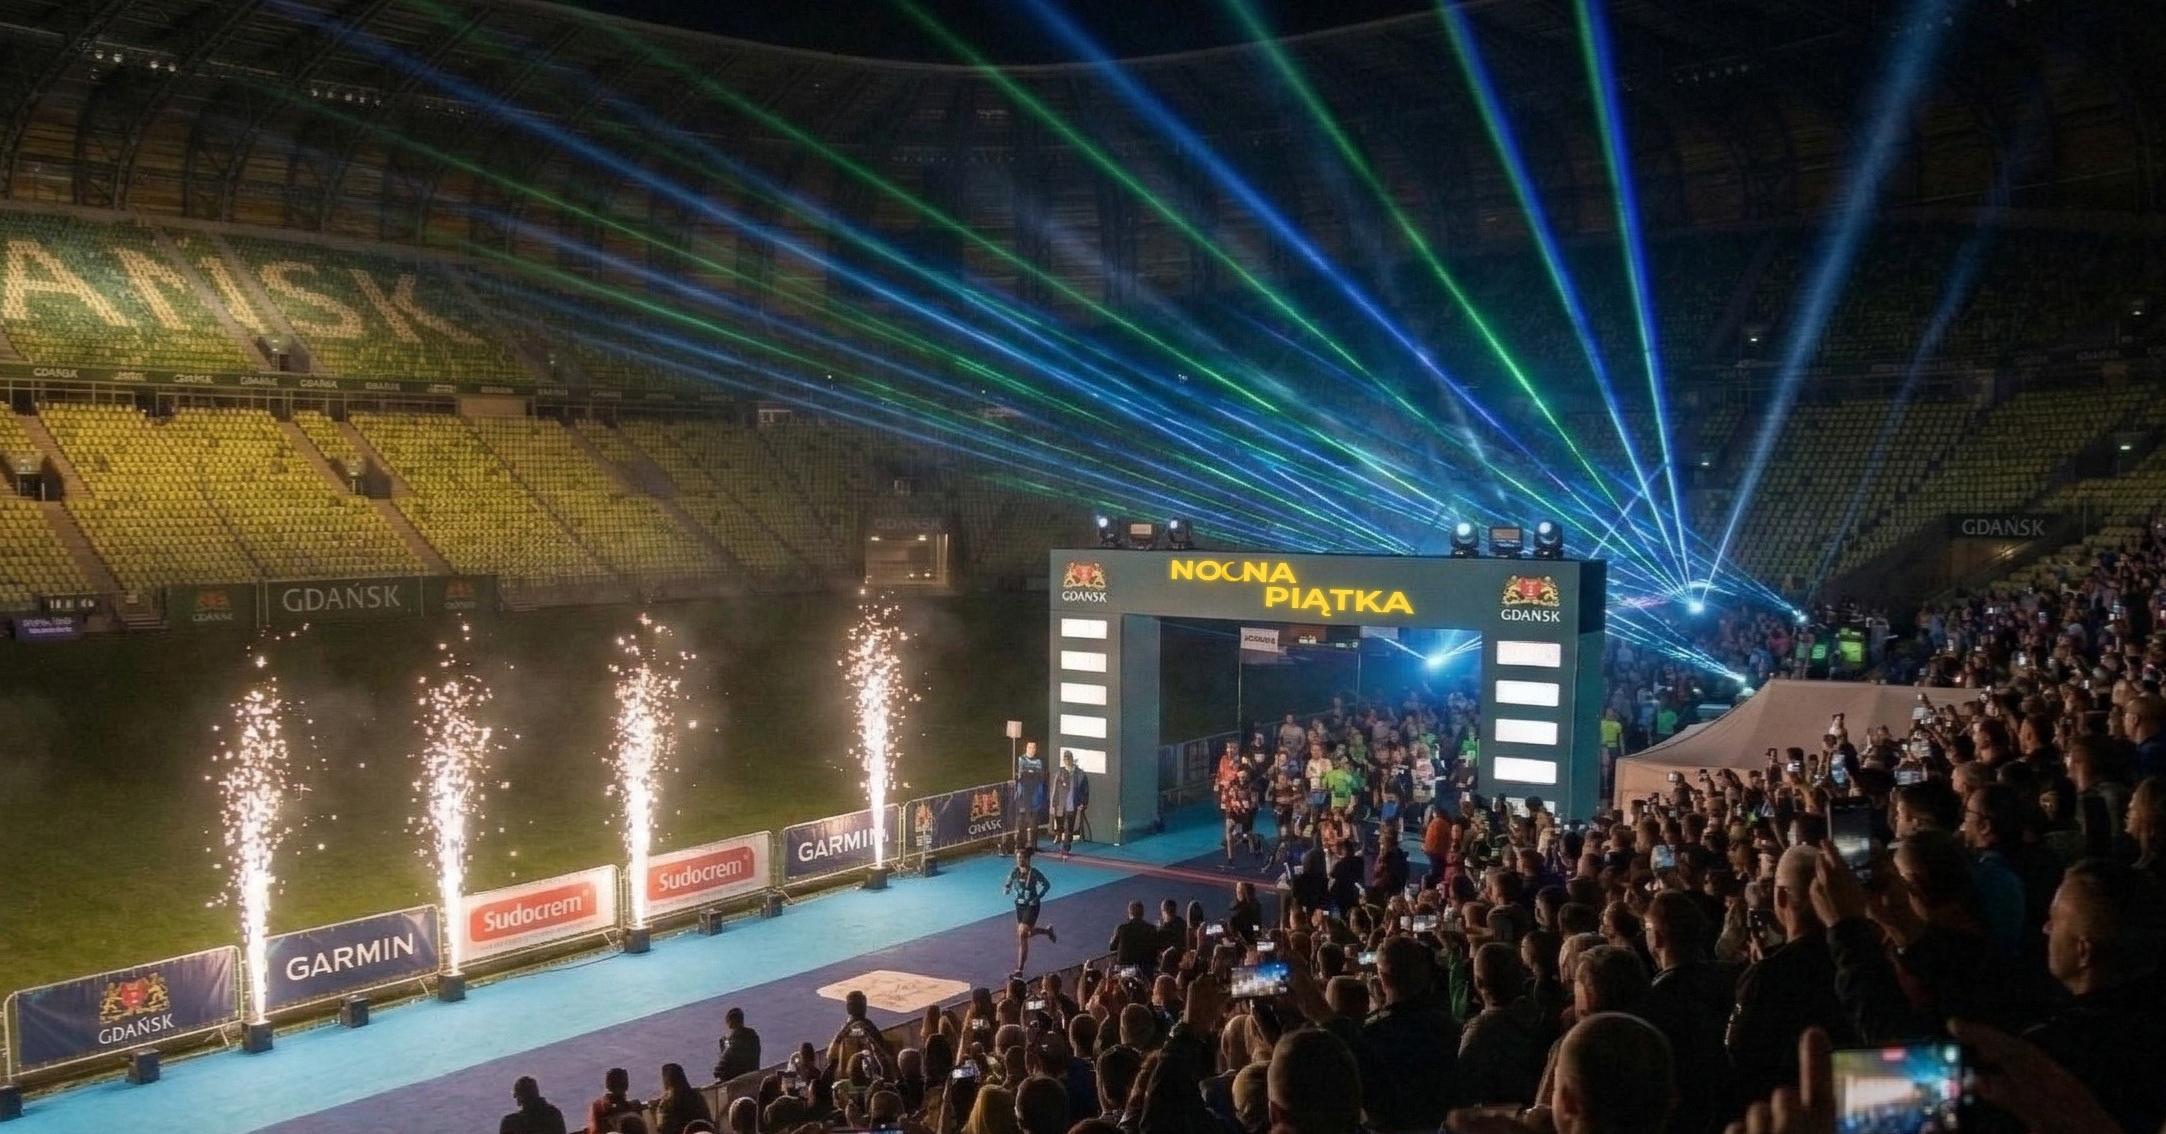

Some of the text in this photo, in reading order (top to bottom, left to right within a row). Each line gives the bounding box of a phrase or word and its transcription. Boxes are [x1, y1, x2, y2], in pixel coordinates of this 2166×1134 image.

[1961, 515, 2046, 537] GDAŃSK
[1170, 560, 1297, 584] NOCNA
[282, 582, 400, 612] GDAŃSK
[1265, 586, 1415, 617] PIĄTKA
[658, 860, 743, 892] Sudocrem
[483, 896, 583, 932] Sudocrem
[286, 933, 414, 981] GARMIN
[98, 1013, 175, 1045] GDAŃSK
